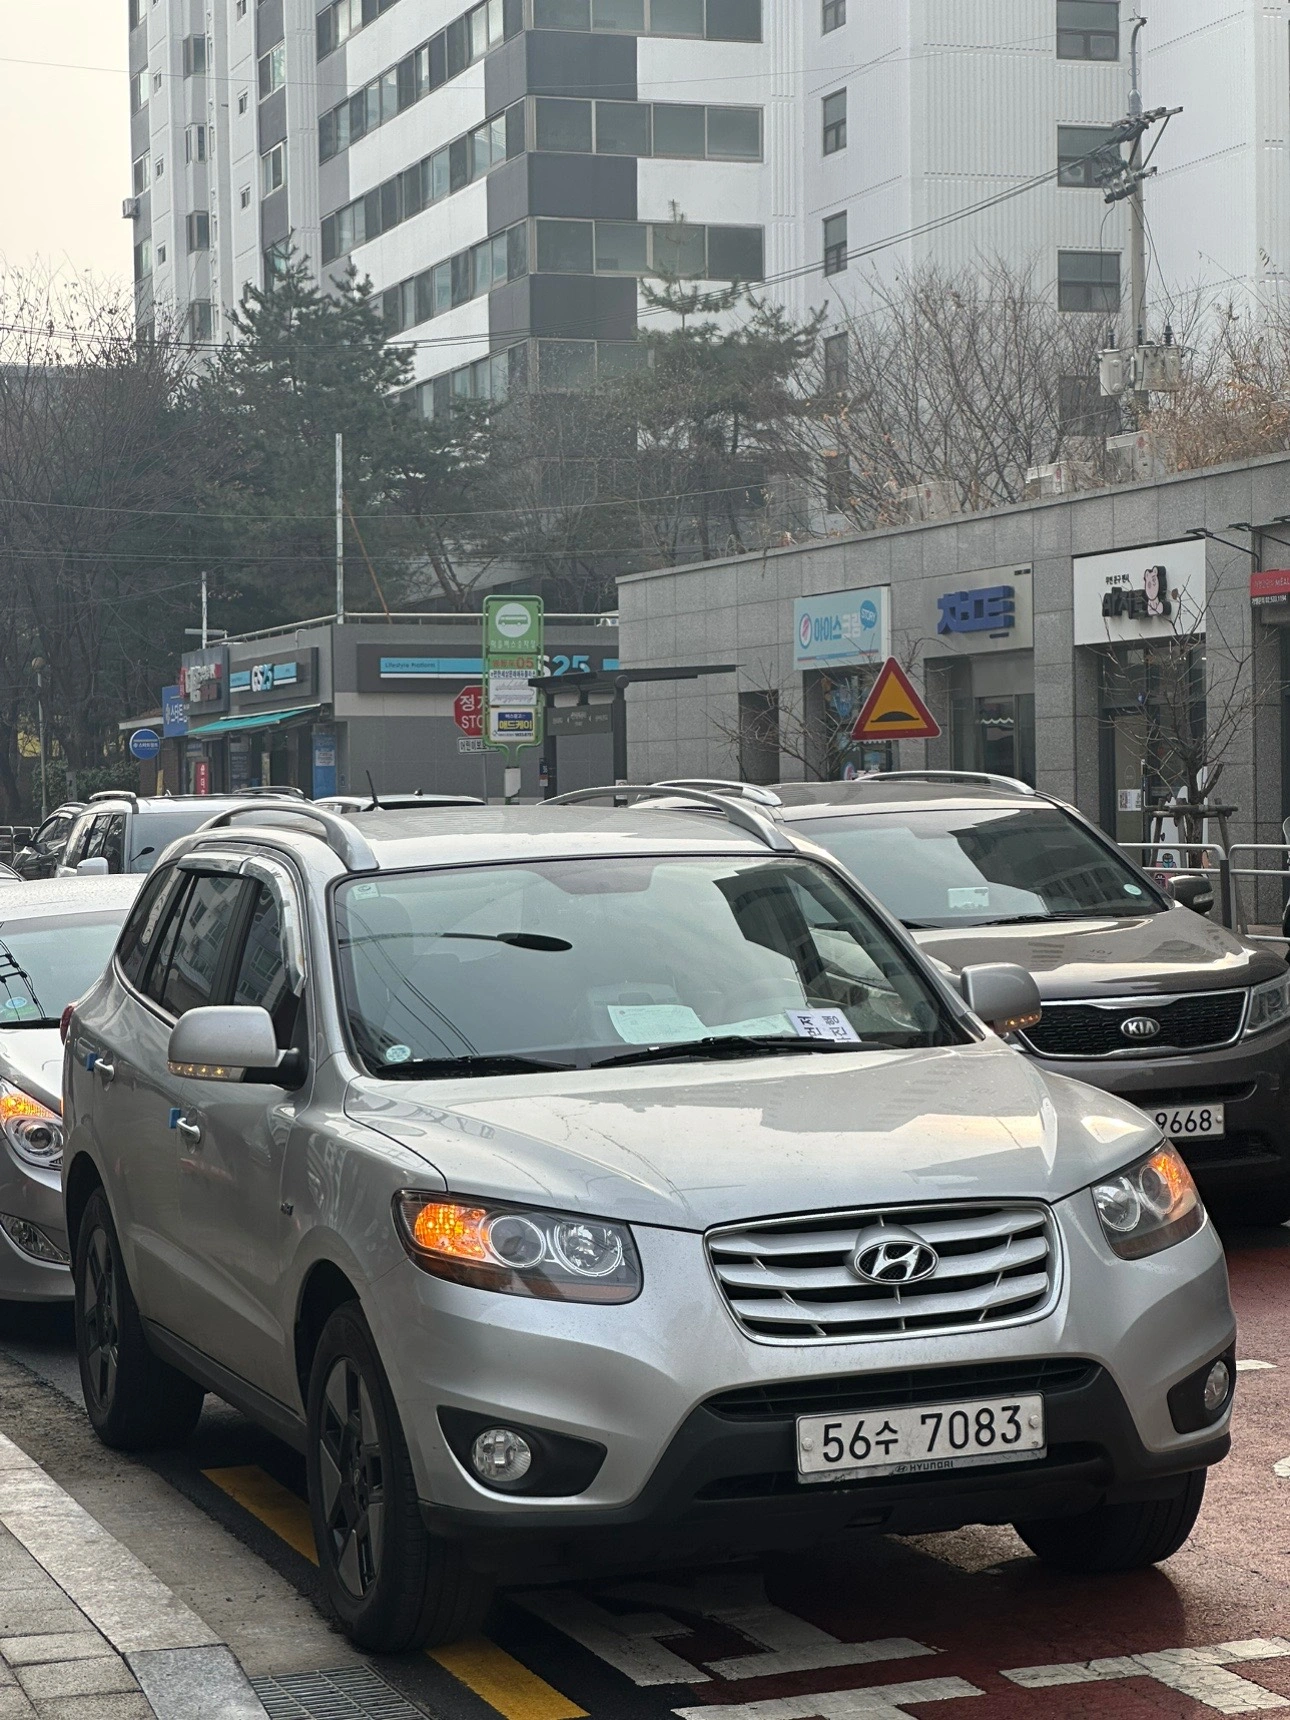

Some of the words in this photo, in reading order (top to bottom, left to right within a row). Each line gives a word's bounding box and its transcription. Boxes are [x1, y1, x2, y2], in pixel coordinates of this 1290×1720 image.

[861, 608, 876, 622] STORY
[814, 612, 861, 642] 아이스크림
[537, 655, 591, 677] S25
[251, 663, 273, 692] GS25
[461, 715, 483, 729] STO
[499, 720, 533, 730] 애드케이
[1127, 1021, 1156, 1034] KIA
[1155, 1109, 1212, 1134] 9668
[823, 1420, 899, 1463] 56수
[920, 1405, 1022, 1452] 7083
[909, 1460, 954, 1472] HYUNDAI
